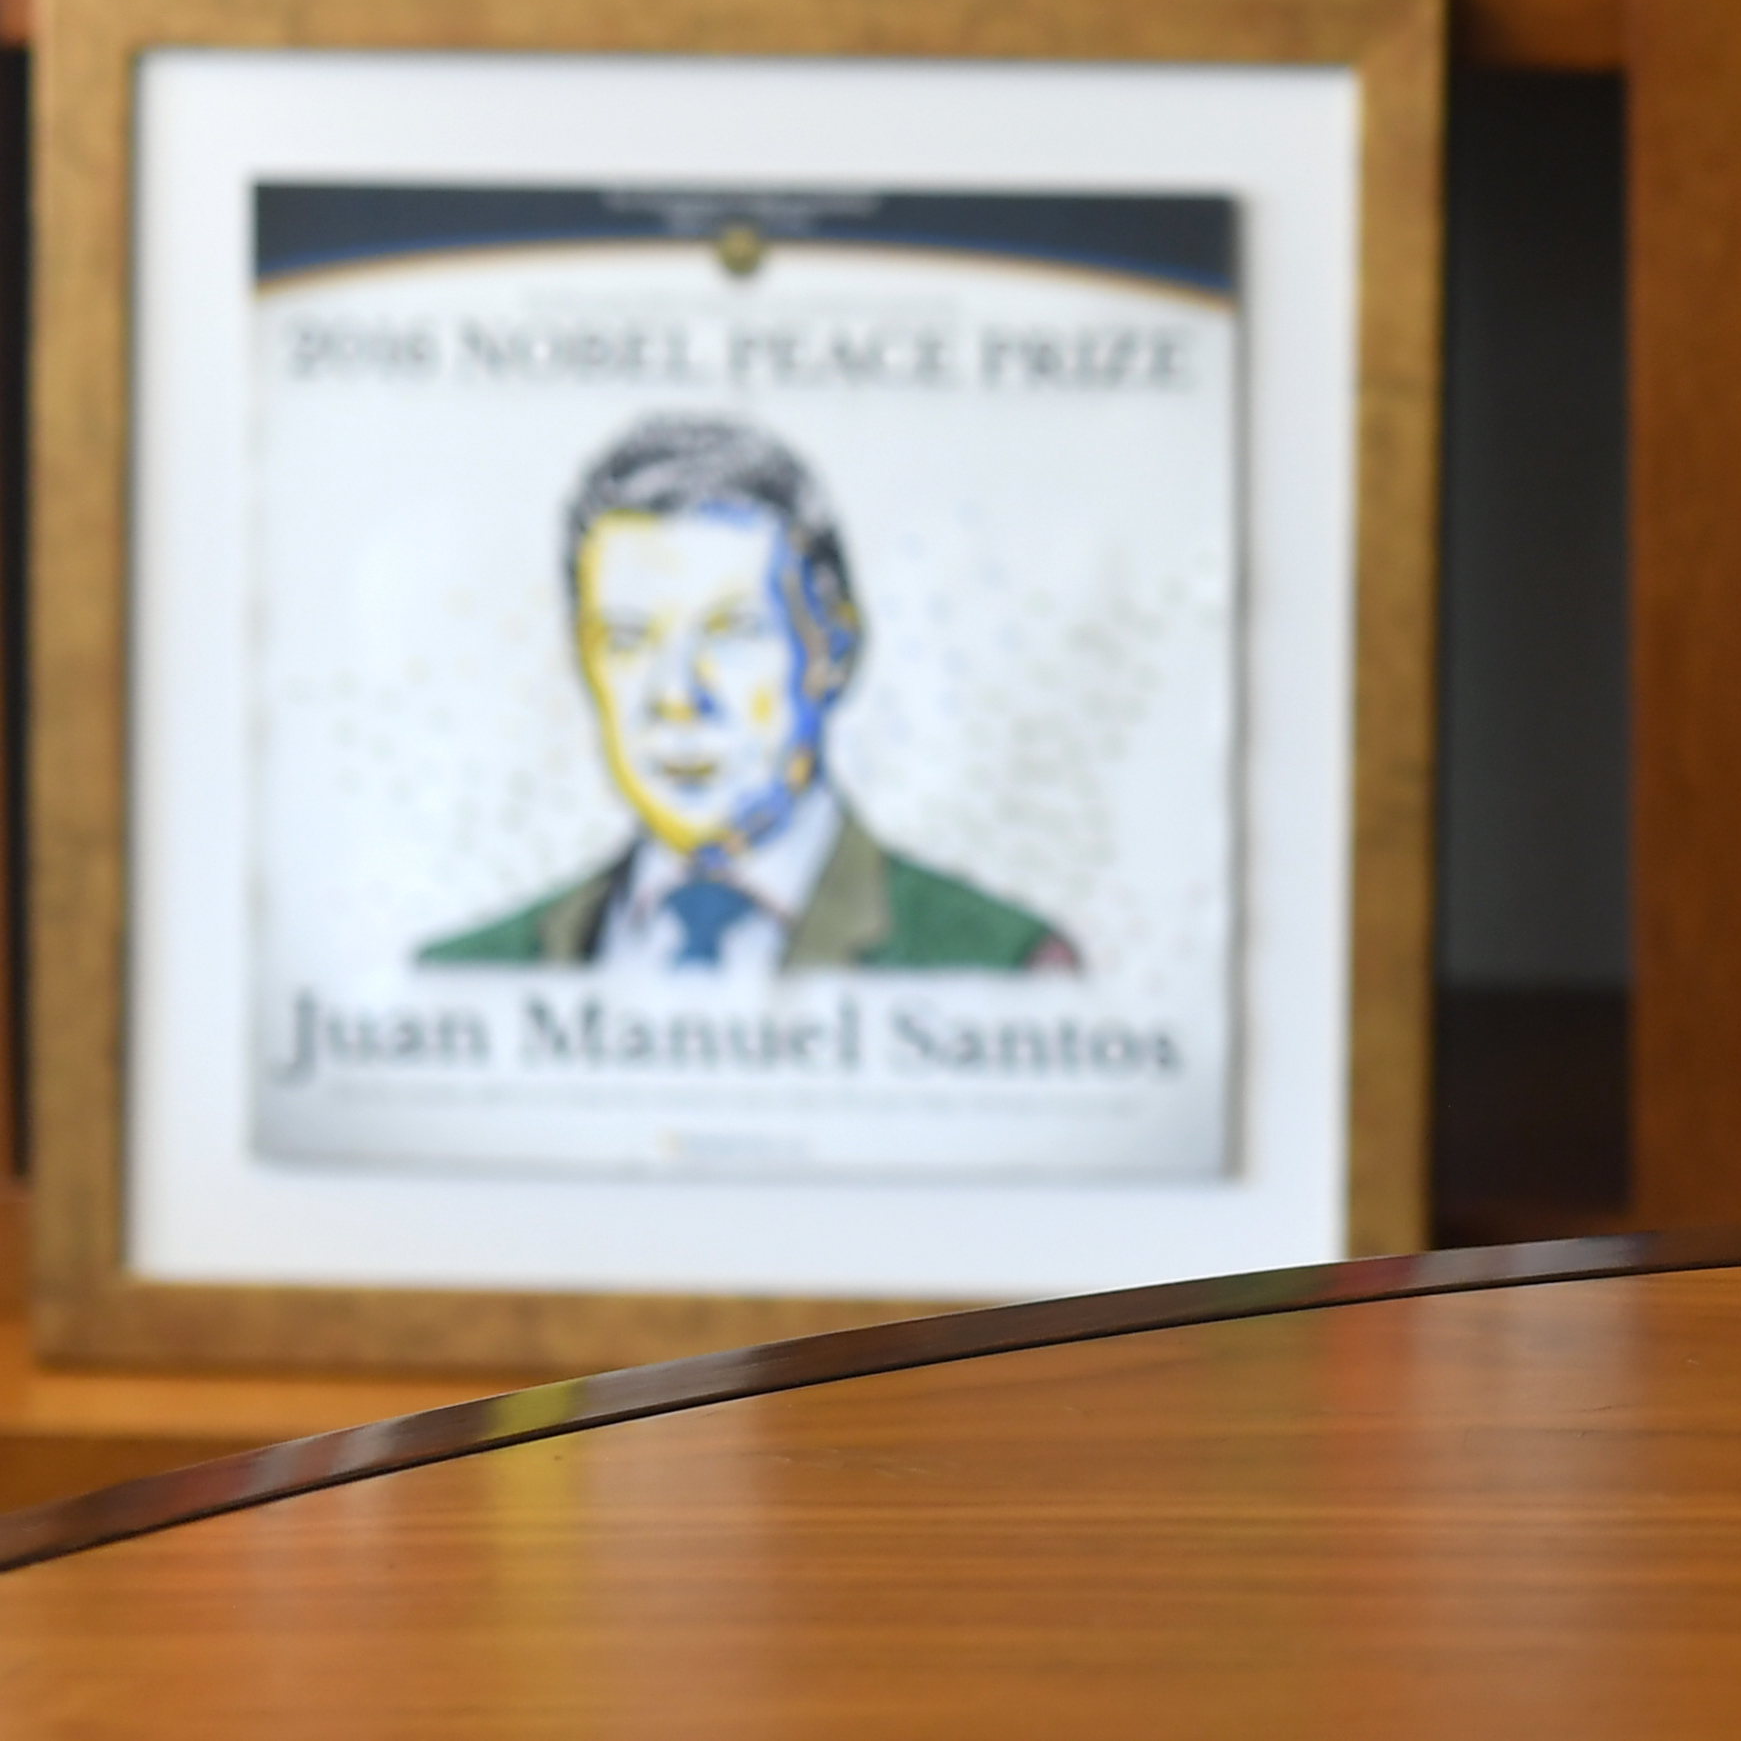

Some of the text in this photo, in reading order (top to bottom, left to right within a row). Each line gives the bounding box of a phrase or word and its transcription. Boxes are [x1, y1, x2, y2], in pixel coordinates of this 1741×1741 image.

[457, 317, 704, 385] NOBEL
[728, 322, 950, 390] PEACE
[978, 324, 1190, 392] PRIZE
[275, 987, 1186, 1087] Juan Manuel Santos
